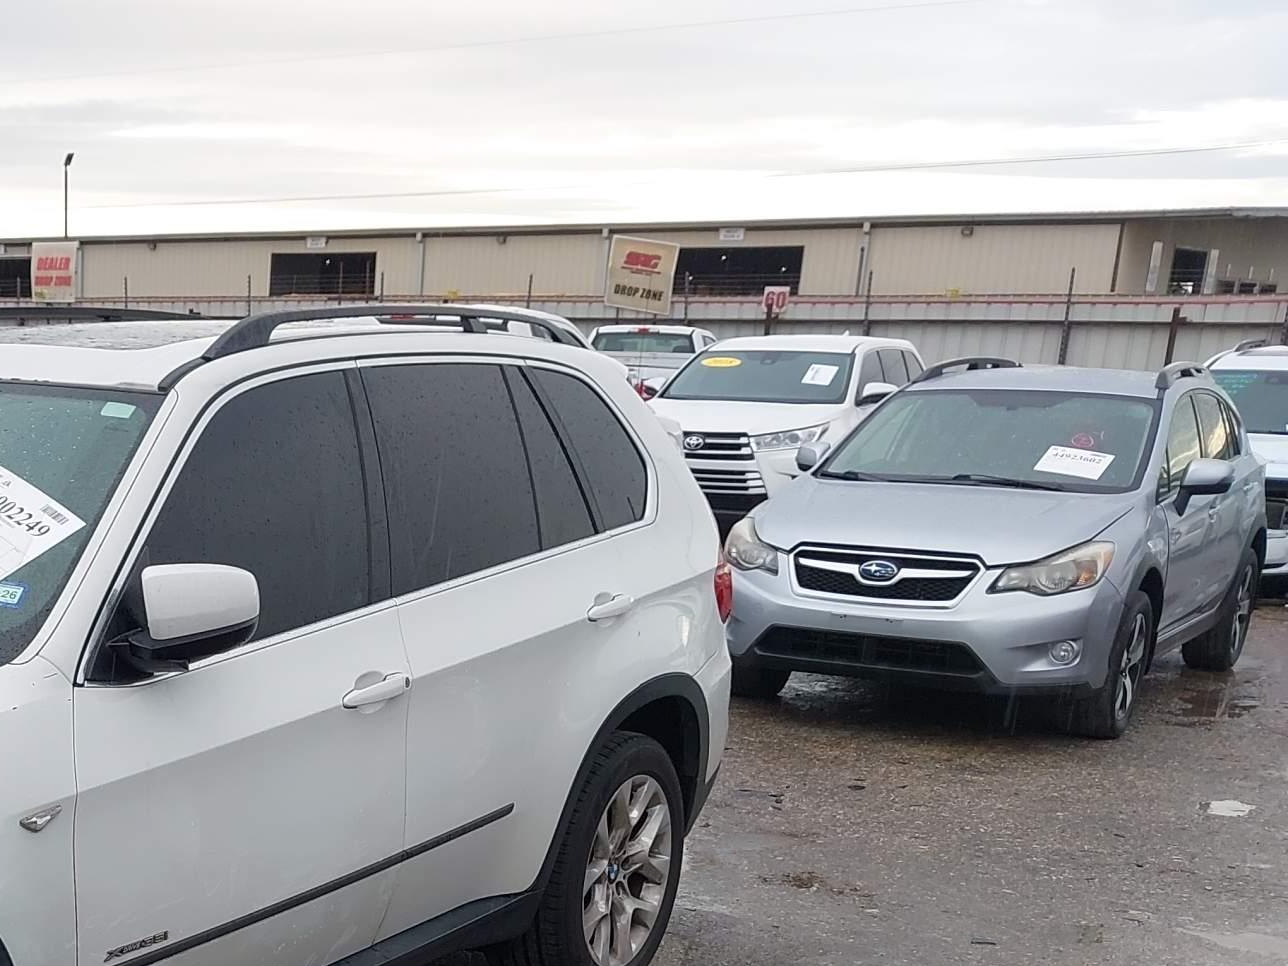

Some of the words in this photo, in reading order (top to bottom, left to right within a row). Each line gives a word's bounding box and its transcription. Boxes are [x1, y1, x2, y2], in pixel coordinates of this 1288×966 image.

[36, 257, 71, 271] DEALER
[613, 283, 639, 297] DROP
[640, 287, 664, 302] ZONE
